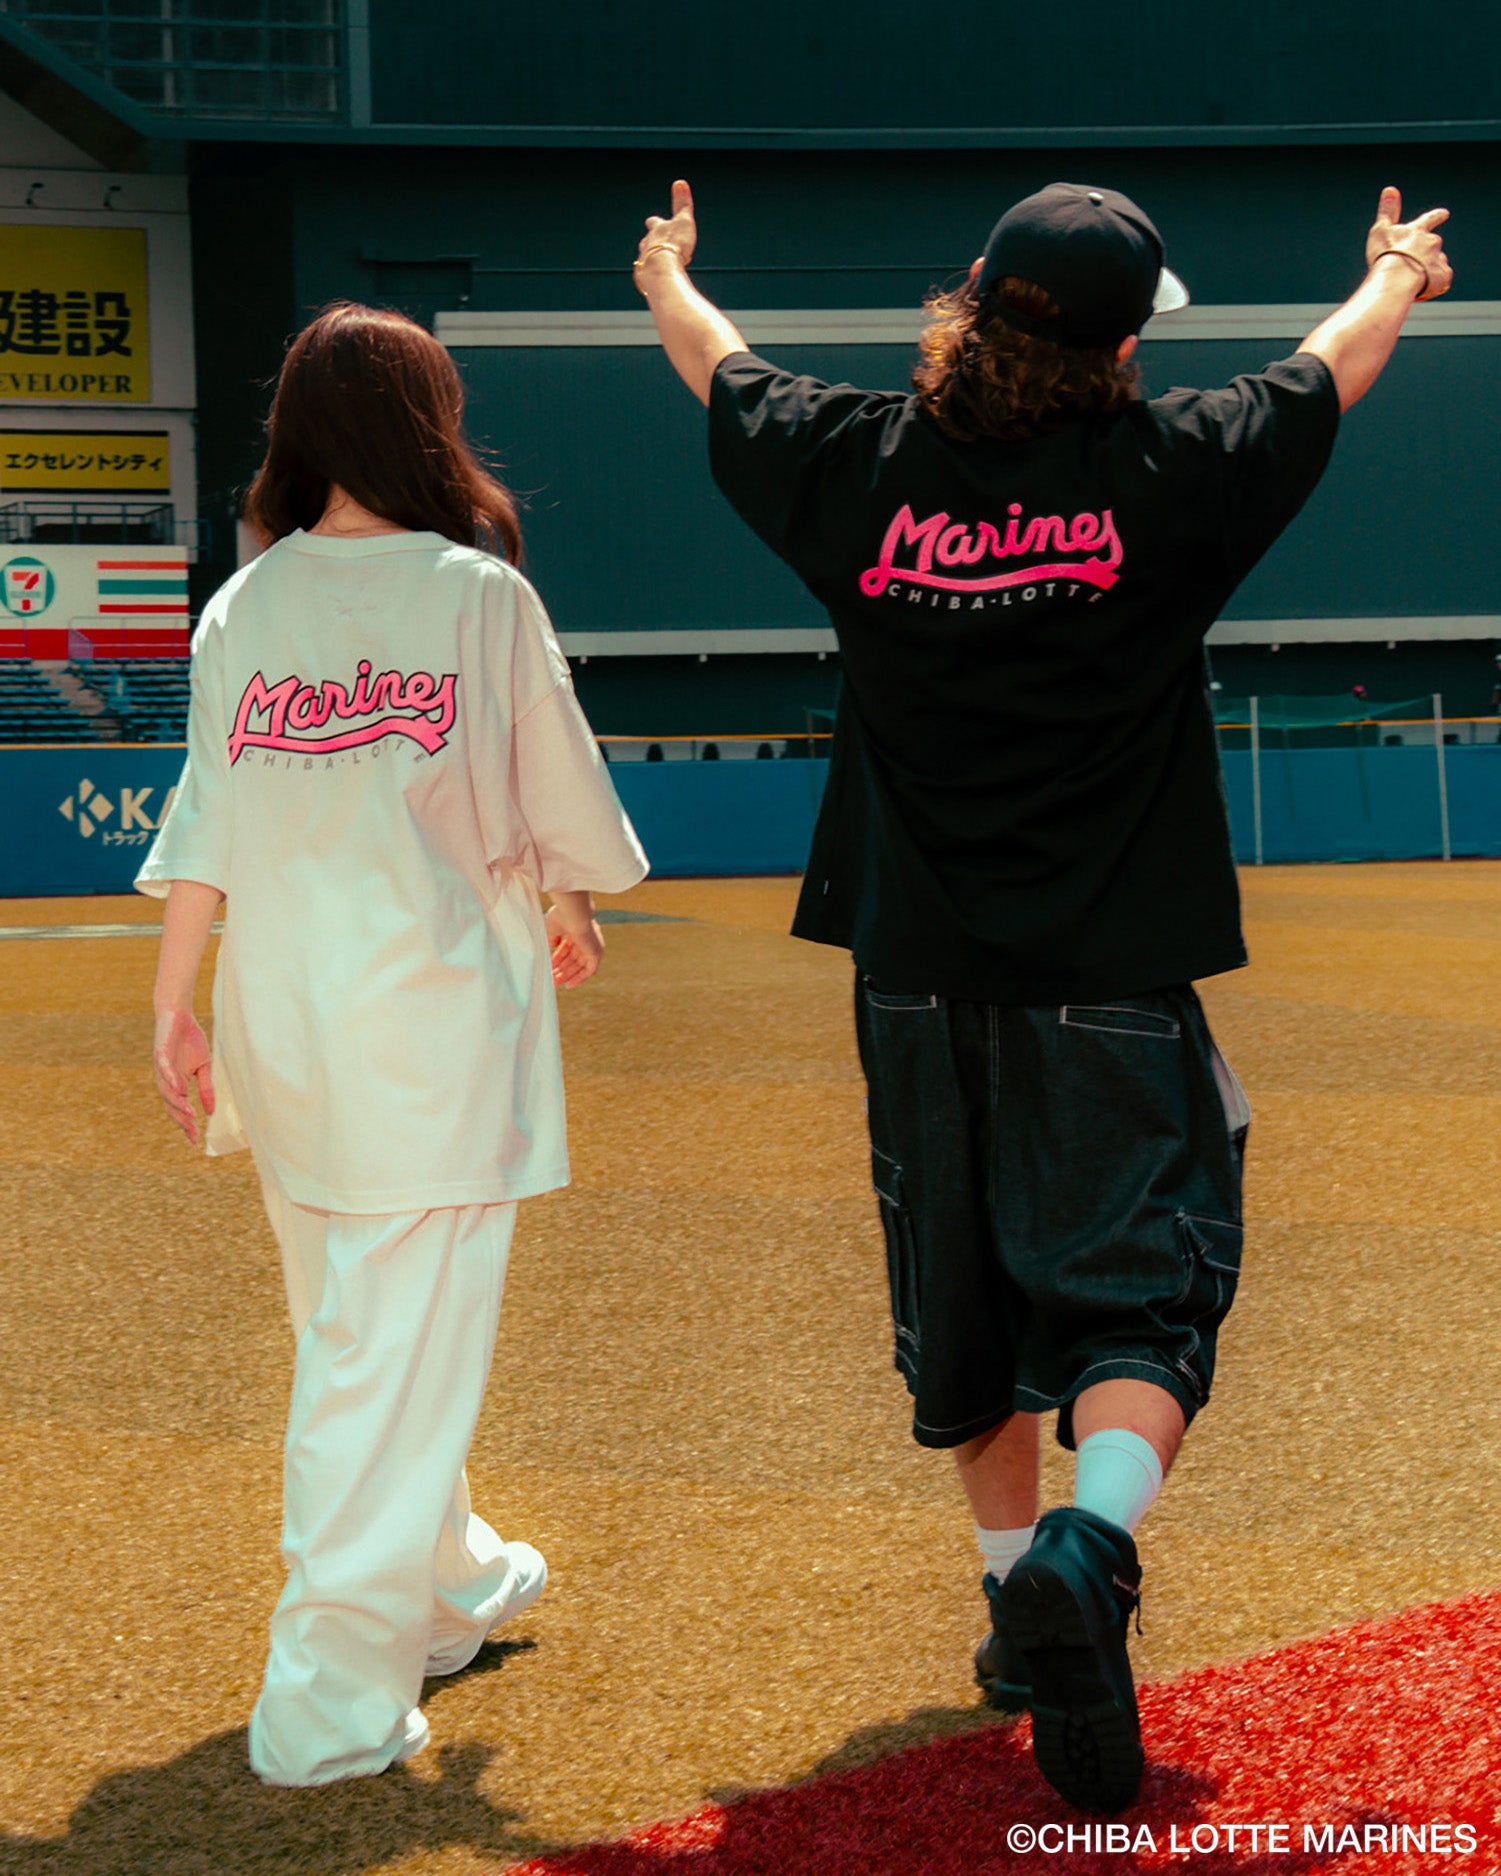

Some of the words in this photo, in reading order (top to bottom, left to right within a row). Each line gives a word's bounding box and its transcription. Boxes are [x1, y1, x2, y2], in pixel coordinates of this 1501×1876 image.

[5, 454, 163, 471] エクセレントシティ
[859, 503, 1124, 597] Marines
[227, 659, 458, 767] Marines
